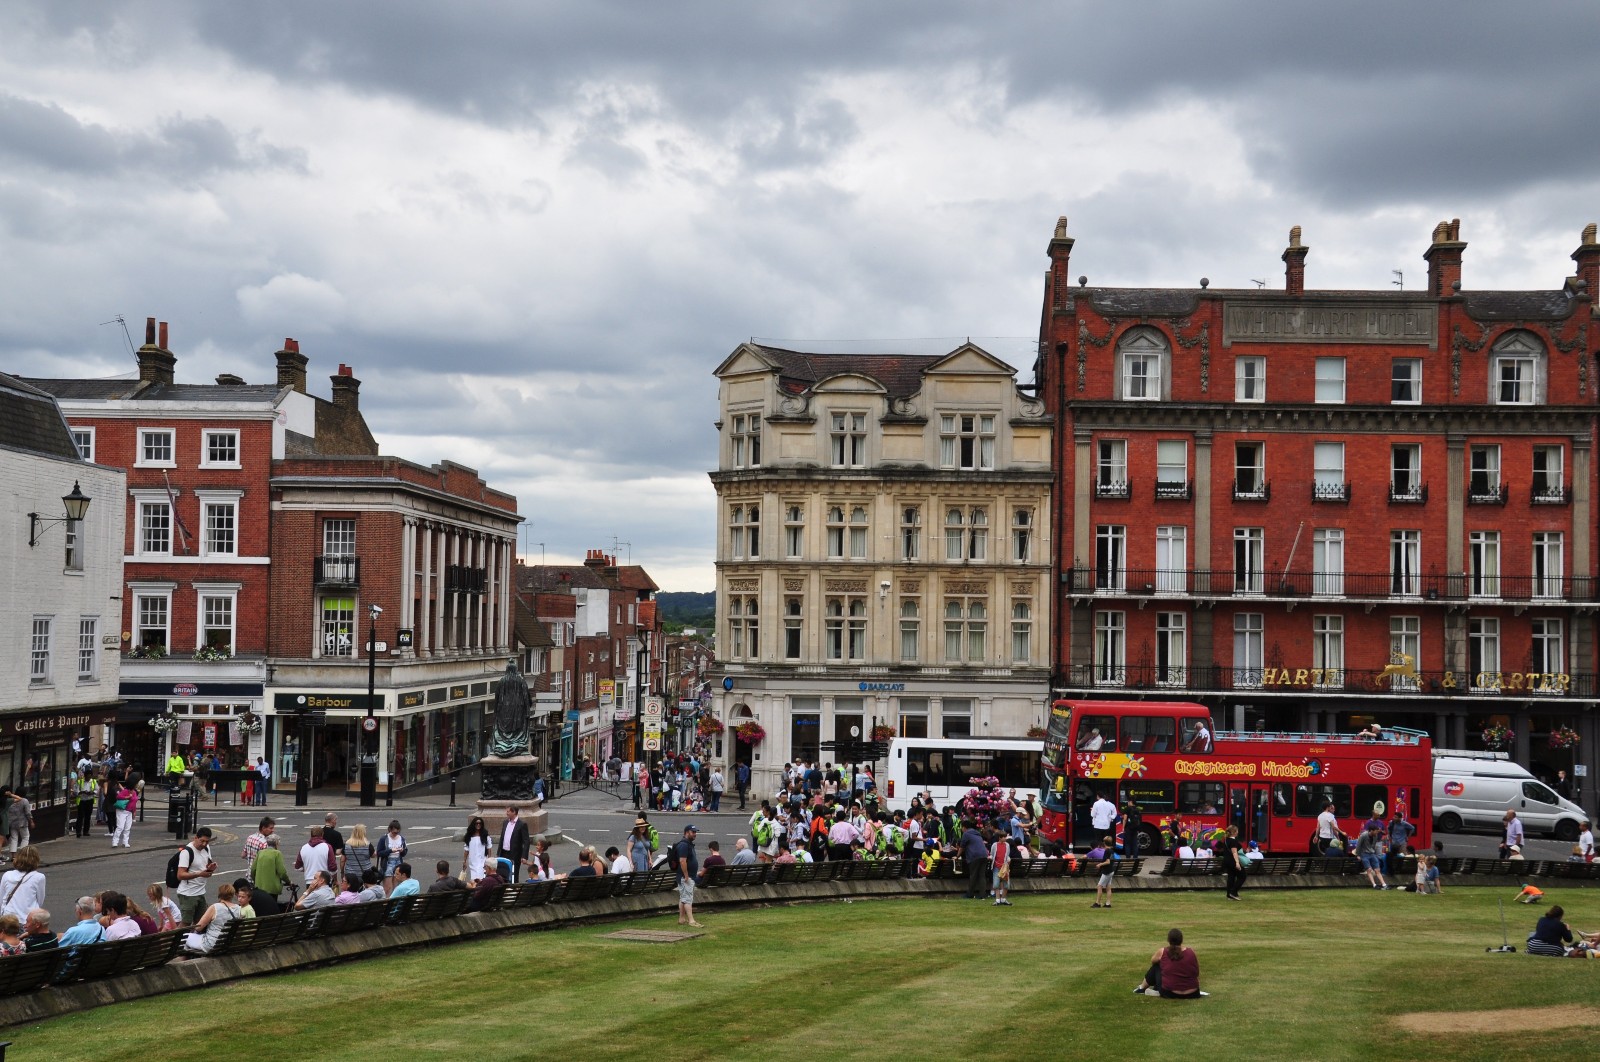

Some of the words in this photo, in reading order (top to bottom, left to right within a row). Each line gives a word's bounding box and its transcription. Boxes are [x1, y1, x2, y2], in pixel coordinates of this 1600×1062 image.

[1233, 310, 1296, 335] WHITE
[1303, 311, 1354, 335] HART
[1365, 312, 1428, 336] HOTEL
[867, 683, 905, 691] BARCLAYS
[1263, 668, 1339, 685] HARTE
[1442, 671, 1456, 688] &
[1476, 672, 1570, 690] GARTER
[307, 696, 352, 707] Barbour
[15, 718, 54, 731] Castle's
[57, 715, 90, 729] Pantry
[1175, 759, 1256, 777] CitySightseeing
[1261, 760, 1314, 778] Windsor
